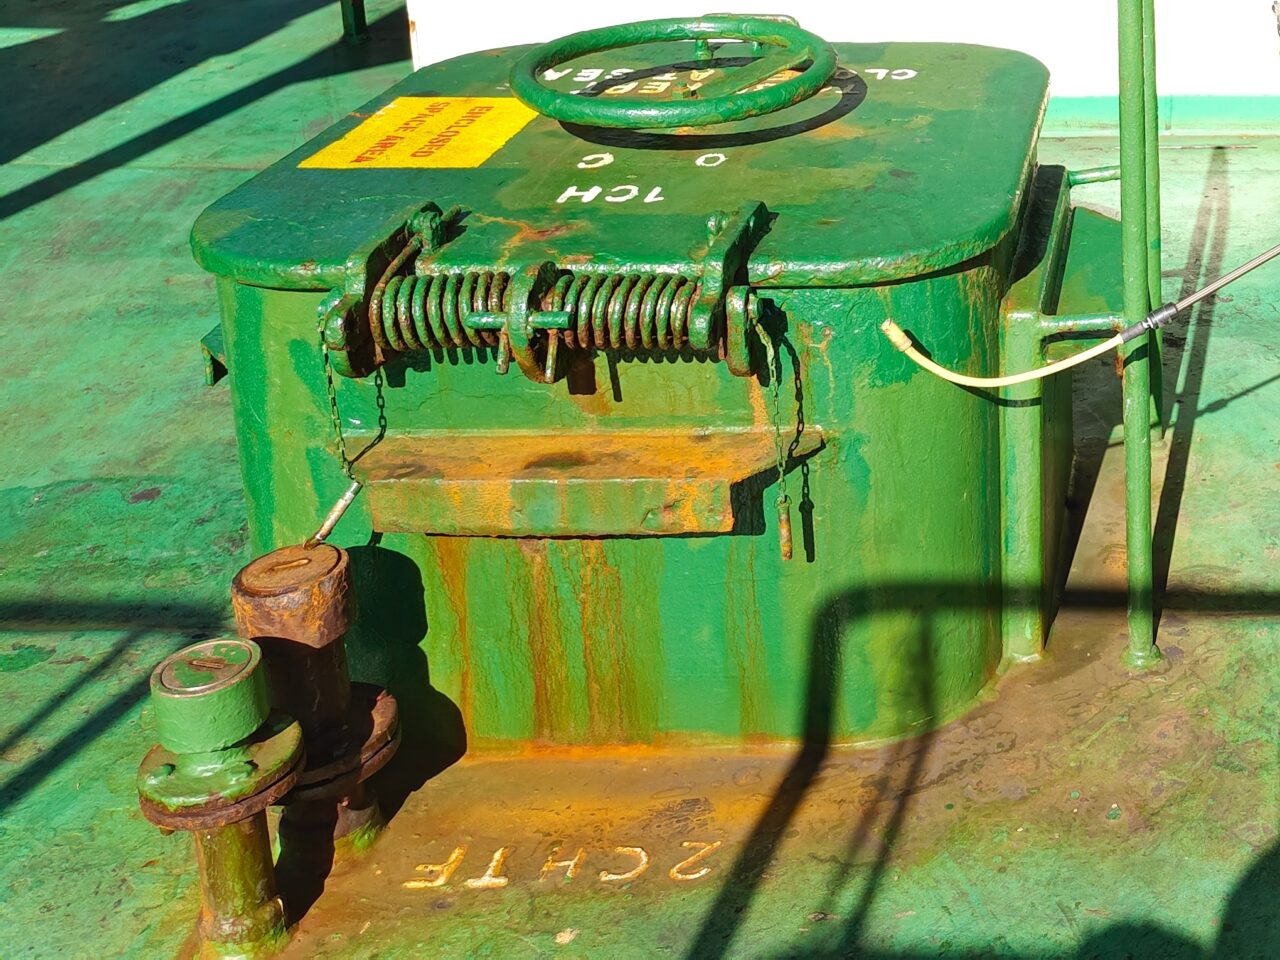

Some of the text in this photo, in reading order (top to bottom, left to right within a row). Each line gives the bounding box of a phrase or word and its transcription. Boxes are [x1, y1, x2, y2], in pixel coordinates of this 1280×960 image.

[350, 101, 450, 163] SPACE AREA
[410, 106, 495, 158] ENCLOSED
[556, 185, 664, 203] 1CH
